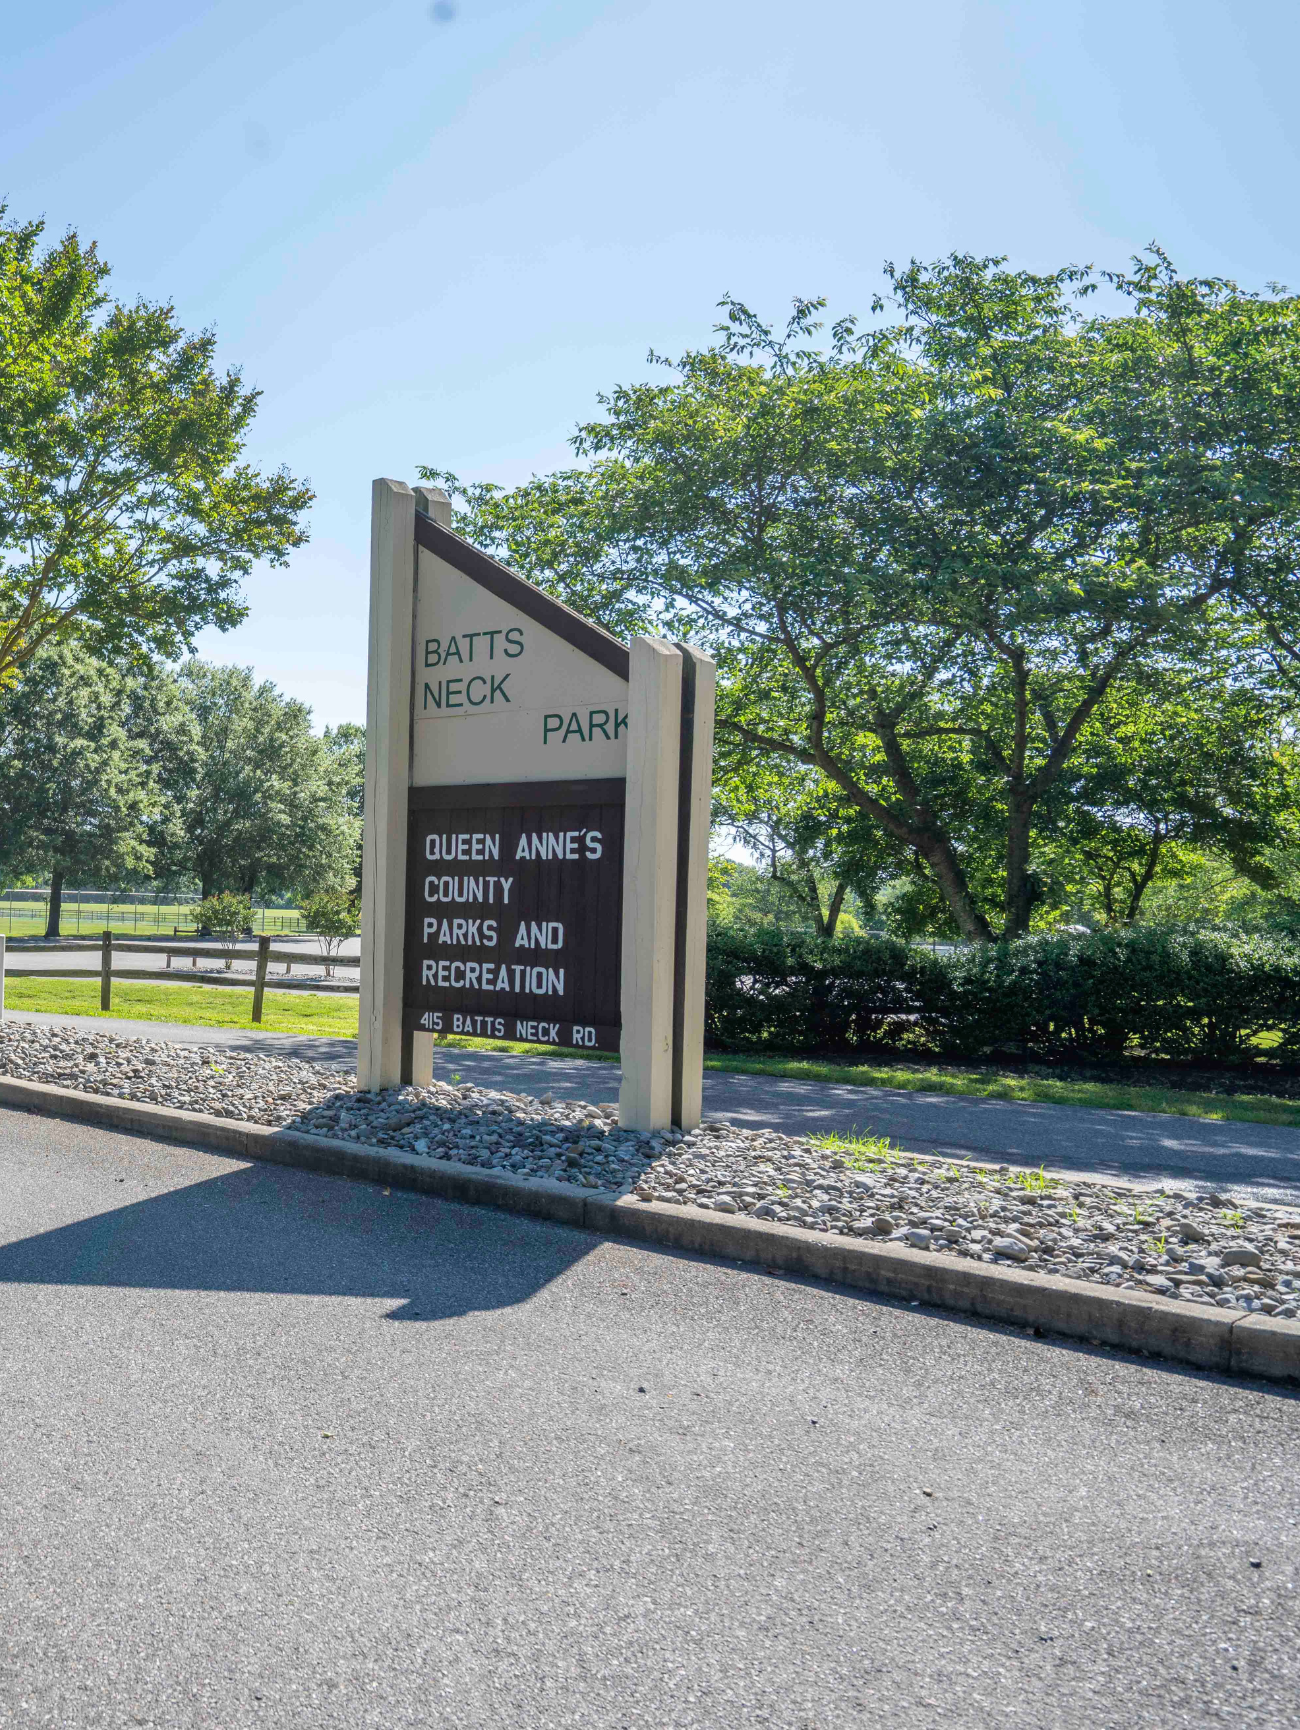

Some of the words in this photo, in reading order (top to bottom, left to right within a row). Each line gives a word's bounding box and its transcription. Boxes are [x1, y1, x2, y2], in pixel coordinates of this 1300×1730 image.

[424, 627, 525, 668] BATTS
[423, 673, 512, 710] NECK
[543, 708, 628, 745] PARK
[425, 833, 500, 861] QUEEN
[515, 828, 603, 861] ANNE'S
[424, 876, 514, 904] COUNTY
[423, 917, 498, 947] PARKS
[514, 921, 564, 950] AND
[422, 960, 565, 996] RECREATION
[420, 1012, 443, 1030] 415
[453, 1014, 505, 1037] BATTS
[516, 1020, 560, 1043] NECK
[572, 1025, 599, 1047] RD.
